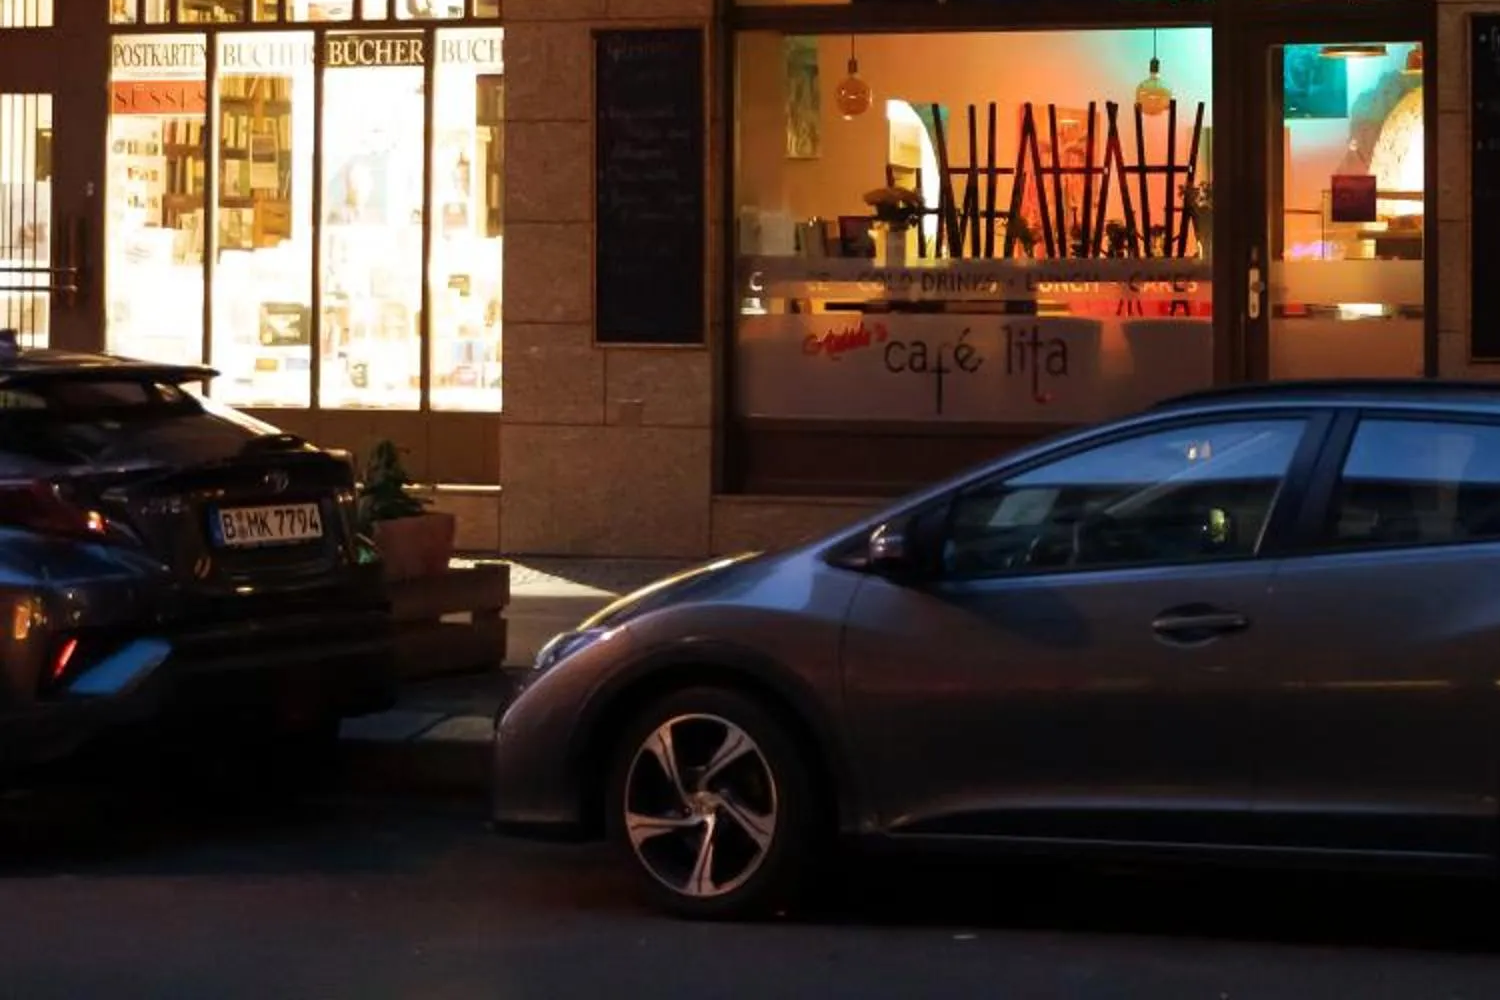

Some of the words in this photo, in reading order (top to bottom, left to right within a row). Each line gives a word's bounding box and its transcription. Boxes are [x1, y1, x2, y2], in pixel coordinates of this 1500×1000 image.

[328, 35, 425, 65] BÜCHER
[1025, 272, 1100, 293] LUNCH
[884, 328, 983, 414] café
[1001, 325, 1068, 403] lita
[222, 513, 236, 539] B
[274, 508, 320, 537] 7794
